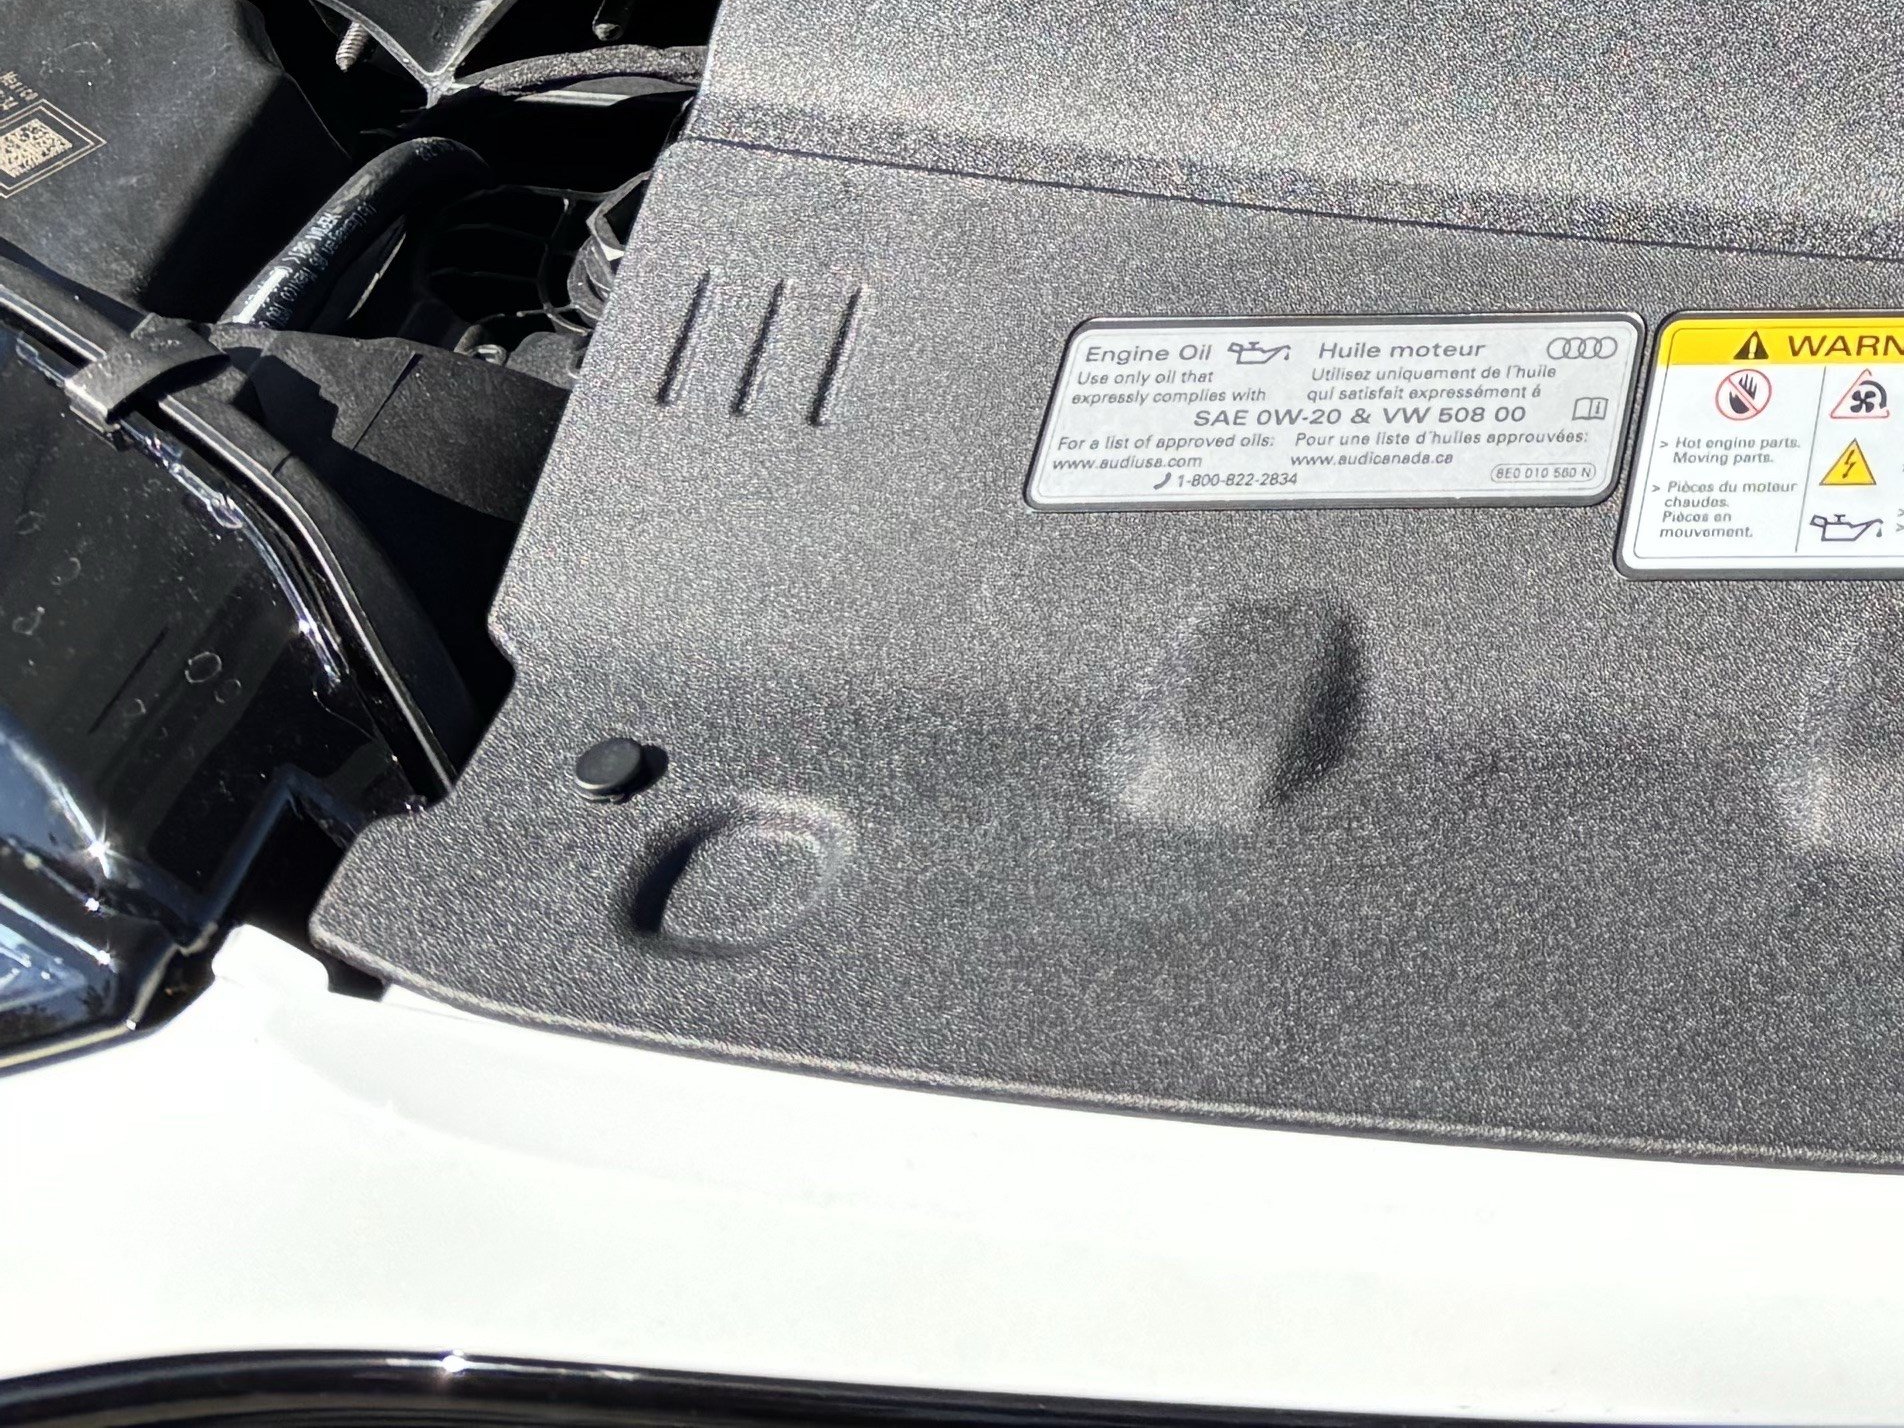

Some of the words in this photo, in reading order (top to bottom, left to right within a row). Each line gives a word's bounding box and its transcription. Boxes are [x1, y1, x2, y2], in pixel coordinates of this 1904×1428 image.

[1086, 346, 1170, 365] Engine
[1179, 344, 1212, 361] Oil
[1318, 342, 1381, 359] Huile
[1390, 342, 1486, 358] moteur
[1077, 371, 1108, 385] Use
[1114, 372, 1150, 387] only
[1155, 371, 1177, 384] oil
[1182, 371, 1213, 383] that
[1312, 367, 1371, 381] Utilisez
[1376, 367, 1476, 383] uniquement
[1481, 366, 1500, 378] de
[1072, 390, 1148, 406] expressly
[1153, 390, 1226, 405] complies
[1232, 389, 1266, 402] with
[1307, 389, 1333, 404] qui
[1339, 386, 1403, 400] satisfait
[1194, 409, 1248, 426] SAE
[1256, 408, 1341, 426] 0W-20
[1350, 408, 1371, 424] &
[1383, 406, 1431, 424] VW
[1438, 407, 1486, 423] 508
[1494, 406, 1526, 422] 00
[1057, 436, 1085, 450] For
[1090, 439, 1099, 450] a
[1105, 436, 1128, 450] list
[1133, 435, 1152, 449] of
[1156, 434, 1235, 451] approved
[1240, 434, 1275, 447] oils:
[1295, 432, 1334, 447] Pour
[1340, 435, 1370, 445] une
[1376, 432, 1410, 445] liste
[1675, 437, 1700, 449] Hot
[1706, 438, 1755, 452] engine
[1053, 456, 1202, 469] www.audiusa.com
[1290, 452, 1453, 467] www.audicanada.ca
[1673, 452, 1729, 466] Moving
[1177, 473, 1297, 487] 1-800-822-2834
[1525, 468, 1548, 478] 010
[1719, 481, 1737, 493] du
[1742, 482, 1798, 493] moteur
[1714, 512, 1731, 522] en
